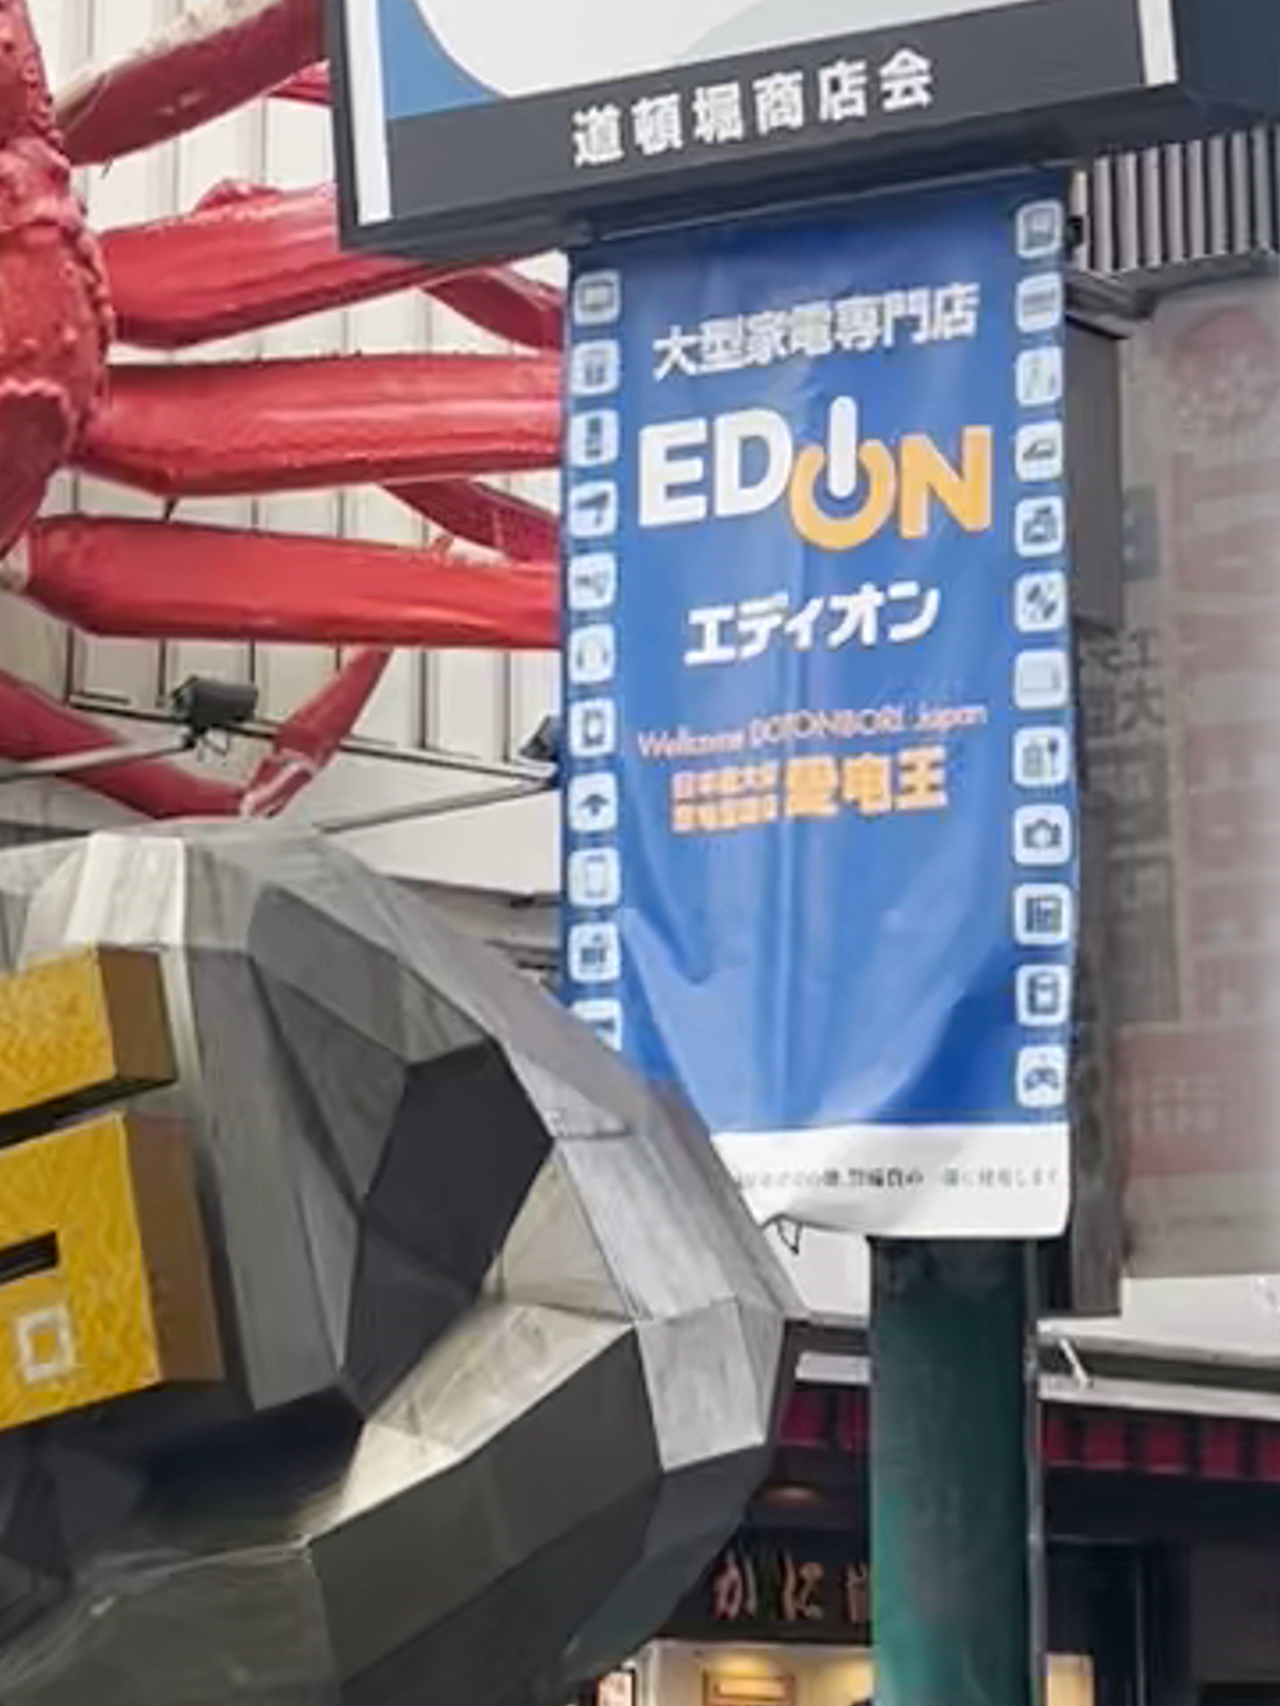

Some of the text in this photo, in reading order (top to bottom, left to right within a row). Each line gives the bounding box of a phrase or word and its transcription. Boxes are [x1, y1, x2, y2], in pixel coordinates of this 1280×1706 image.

[571, 46, 933, 168] 道頓堀商店会
[652, 283, 980, 381] 大型家電専門店
[637, 395, 994, 550] EDION
[683, 581, 940, 665] エディオン
